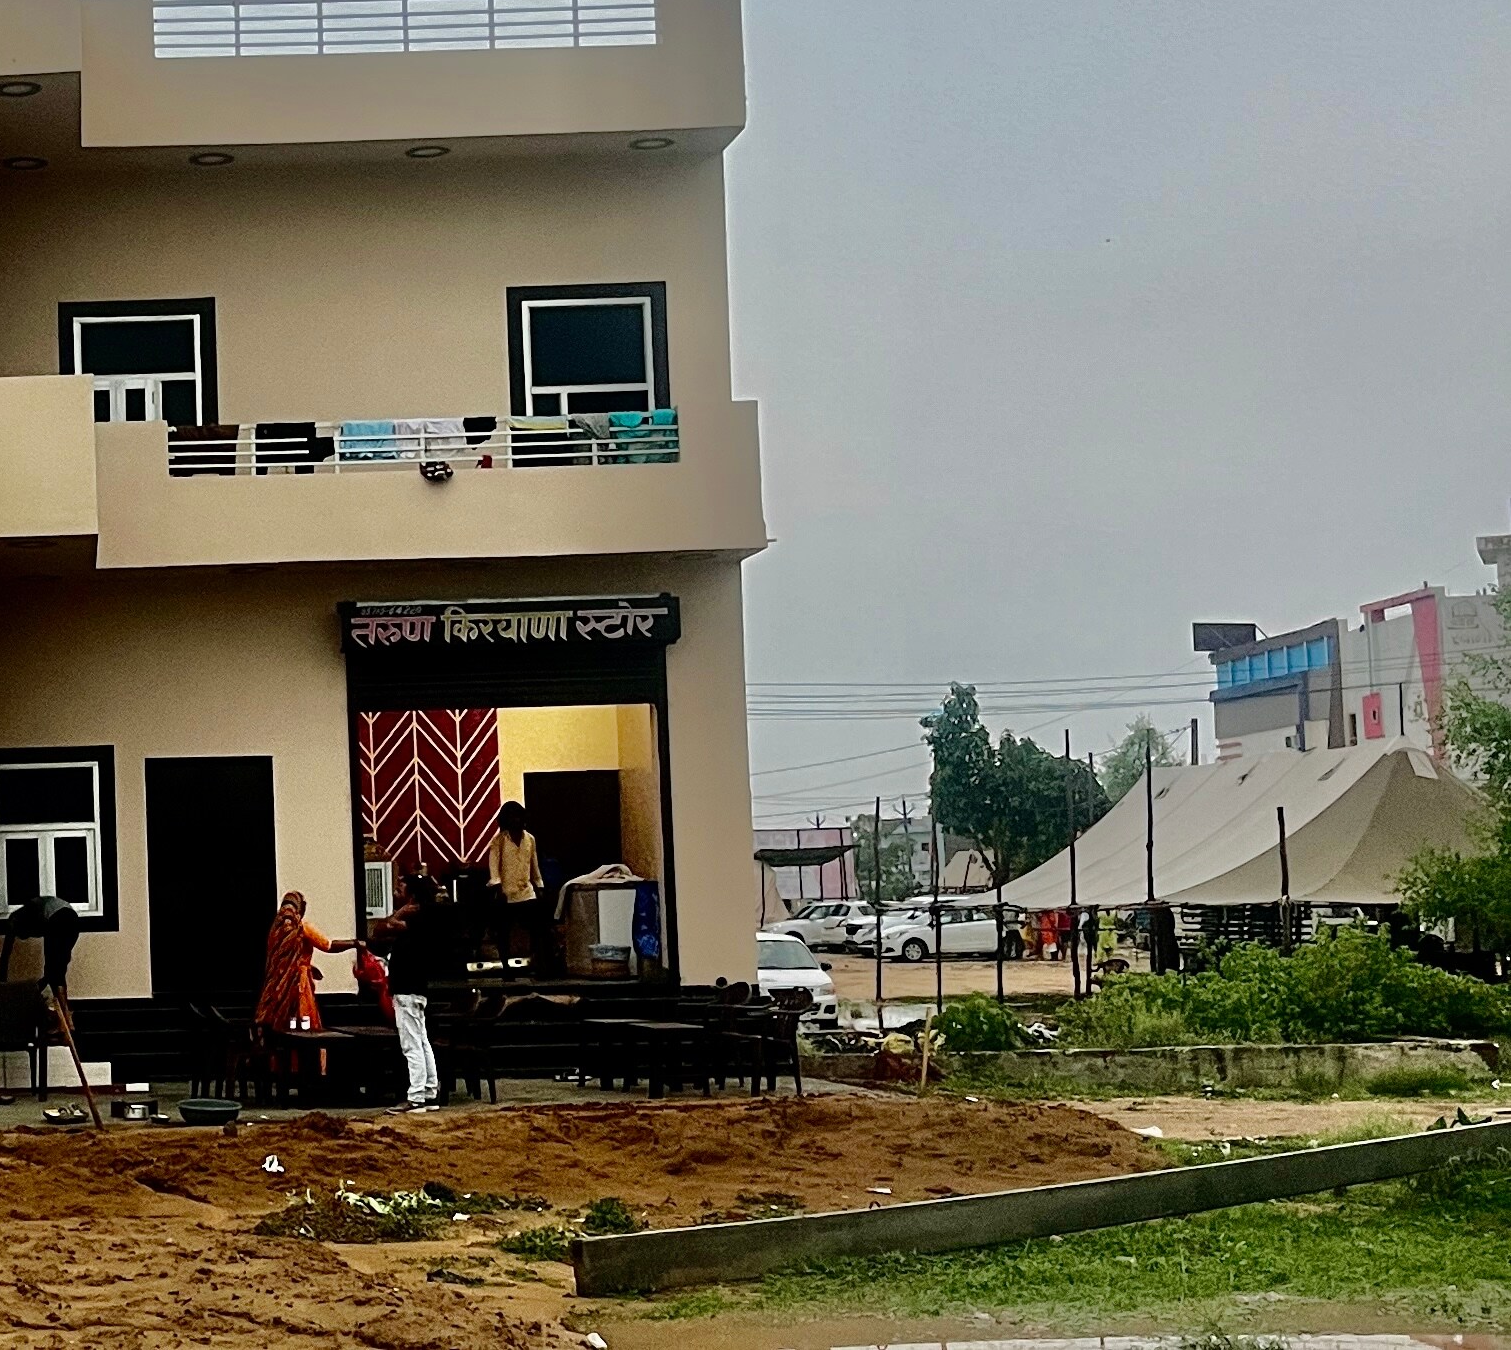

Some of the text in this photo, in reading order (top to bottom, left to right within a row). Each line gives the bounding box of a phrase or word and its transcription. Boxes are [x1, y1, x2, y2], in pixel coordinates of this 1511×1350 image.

[350, 600, 669, 648] तरुण किरयाणा स्टोर
